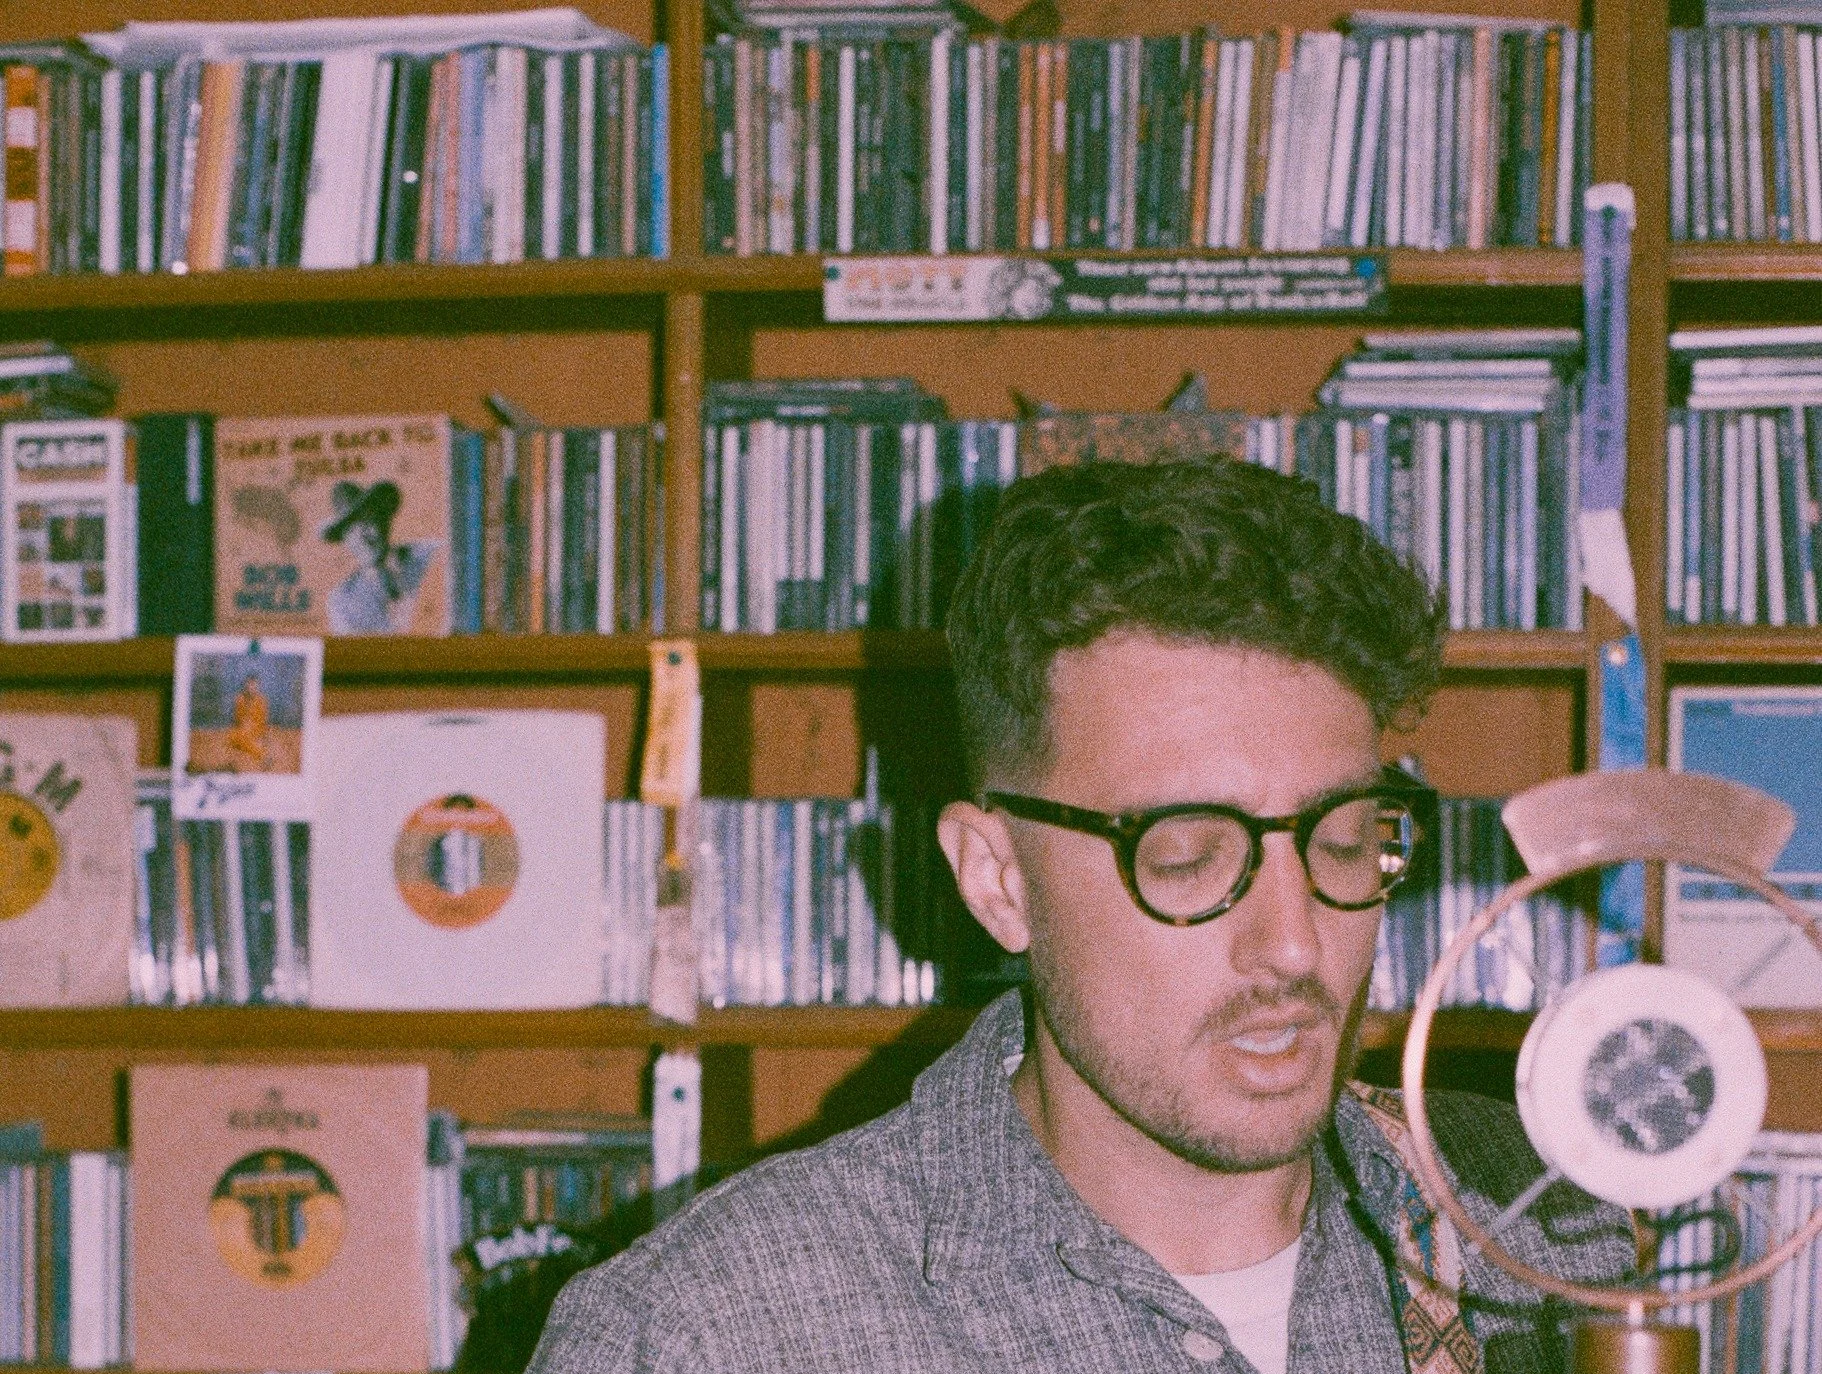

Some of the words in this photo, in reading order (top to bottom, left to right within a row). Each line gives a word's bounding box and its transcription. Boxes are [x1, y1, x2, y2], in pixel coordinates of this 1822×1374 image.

[17, 438, 106, 471] CASH
[222, 437, 278, 459] TAKE
[289, 433, 322, 453] ME
[332, 428, 391, 450] BACK
